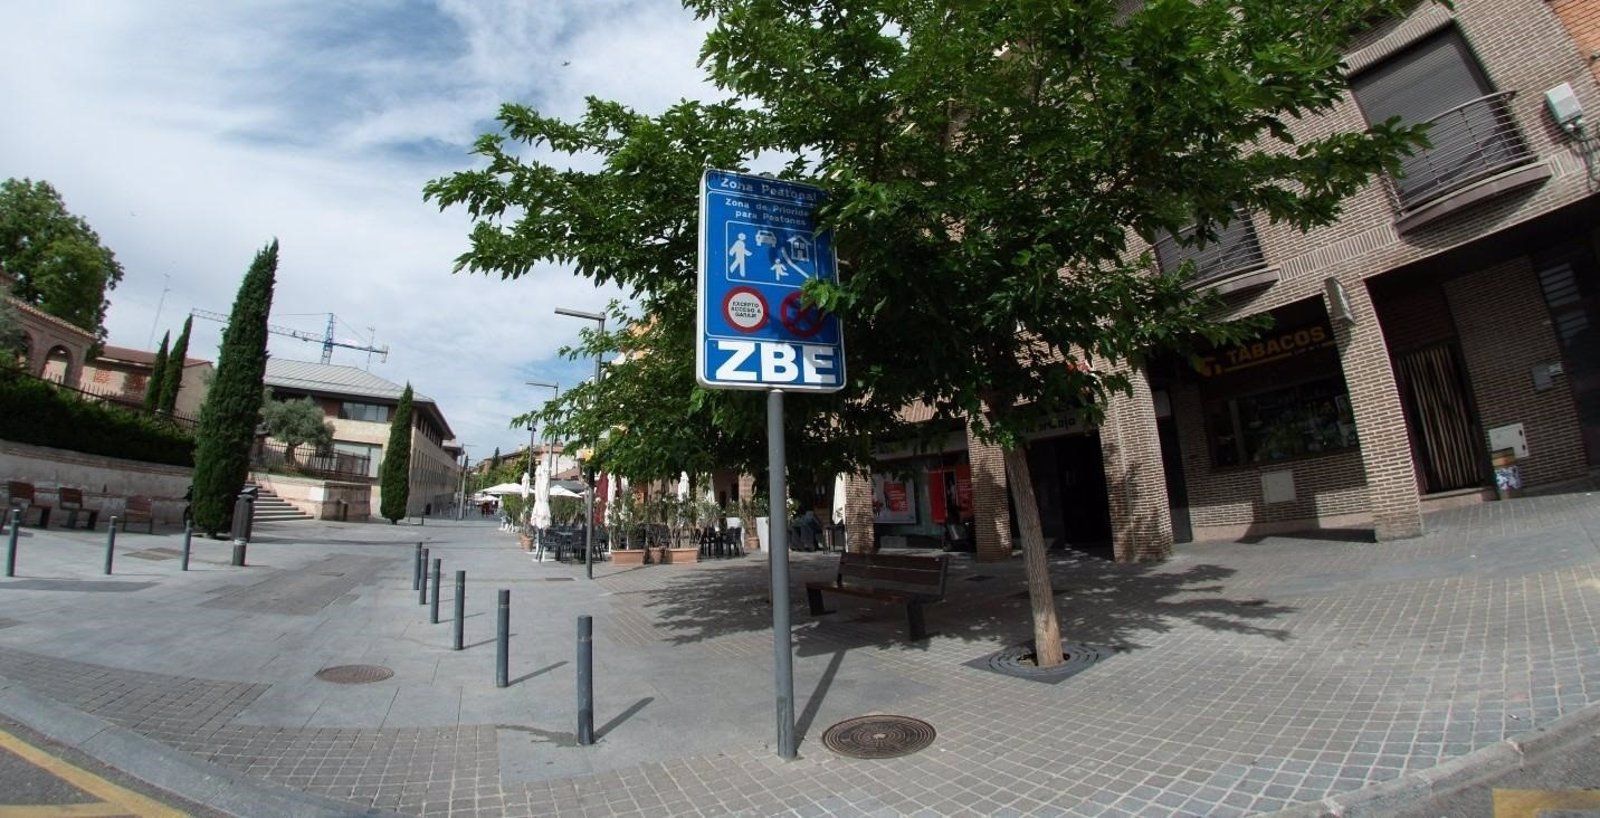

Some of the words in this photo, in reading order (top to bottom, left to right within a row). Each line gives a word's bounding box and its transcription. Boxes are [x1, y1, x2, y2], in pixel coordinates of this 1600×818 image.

[721, 178, 753, 192] Zona
[761, 183, 818, 200] Peatonal
[725, 198, 750, 209] Zona
[756, 202, 768, 210] de
[773, 205, 811, 217] Priorida
[735, 210, 758, 220] para
[763, 212, 807, 226] Peatones
[1225, 326, 1327, 364] TABACOS
[715, 341, 837, 383] ZBE
